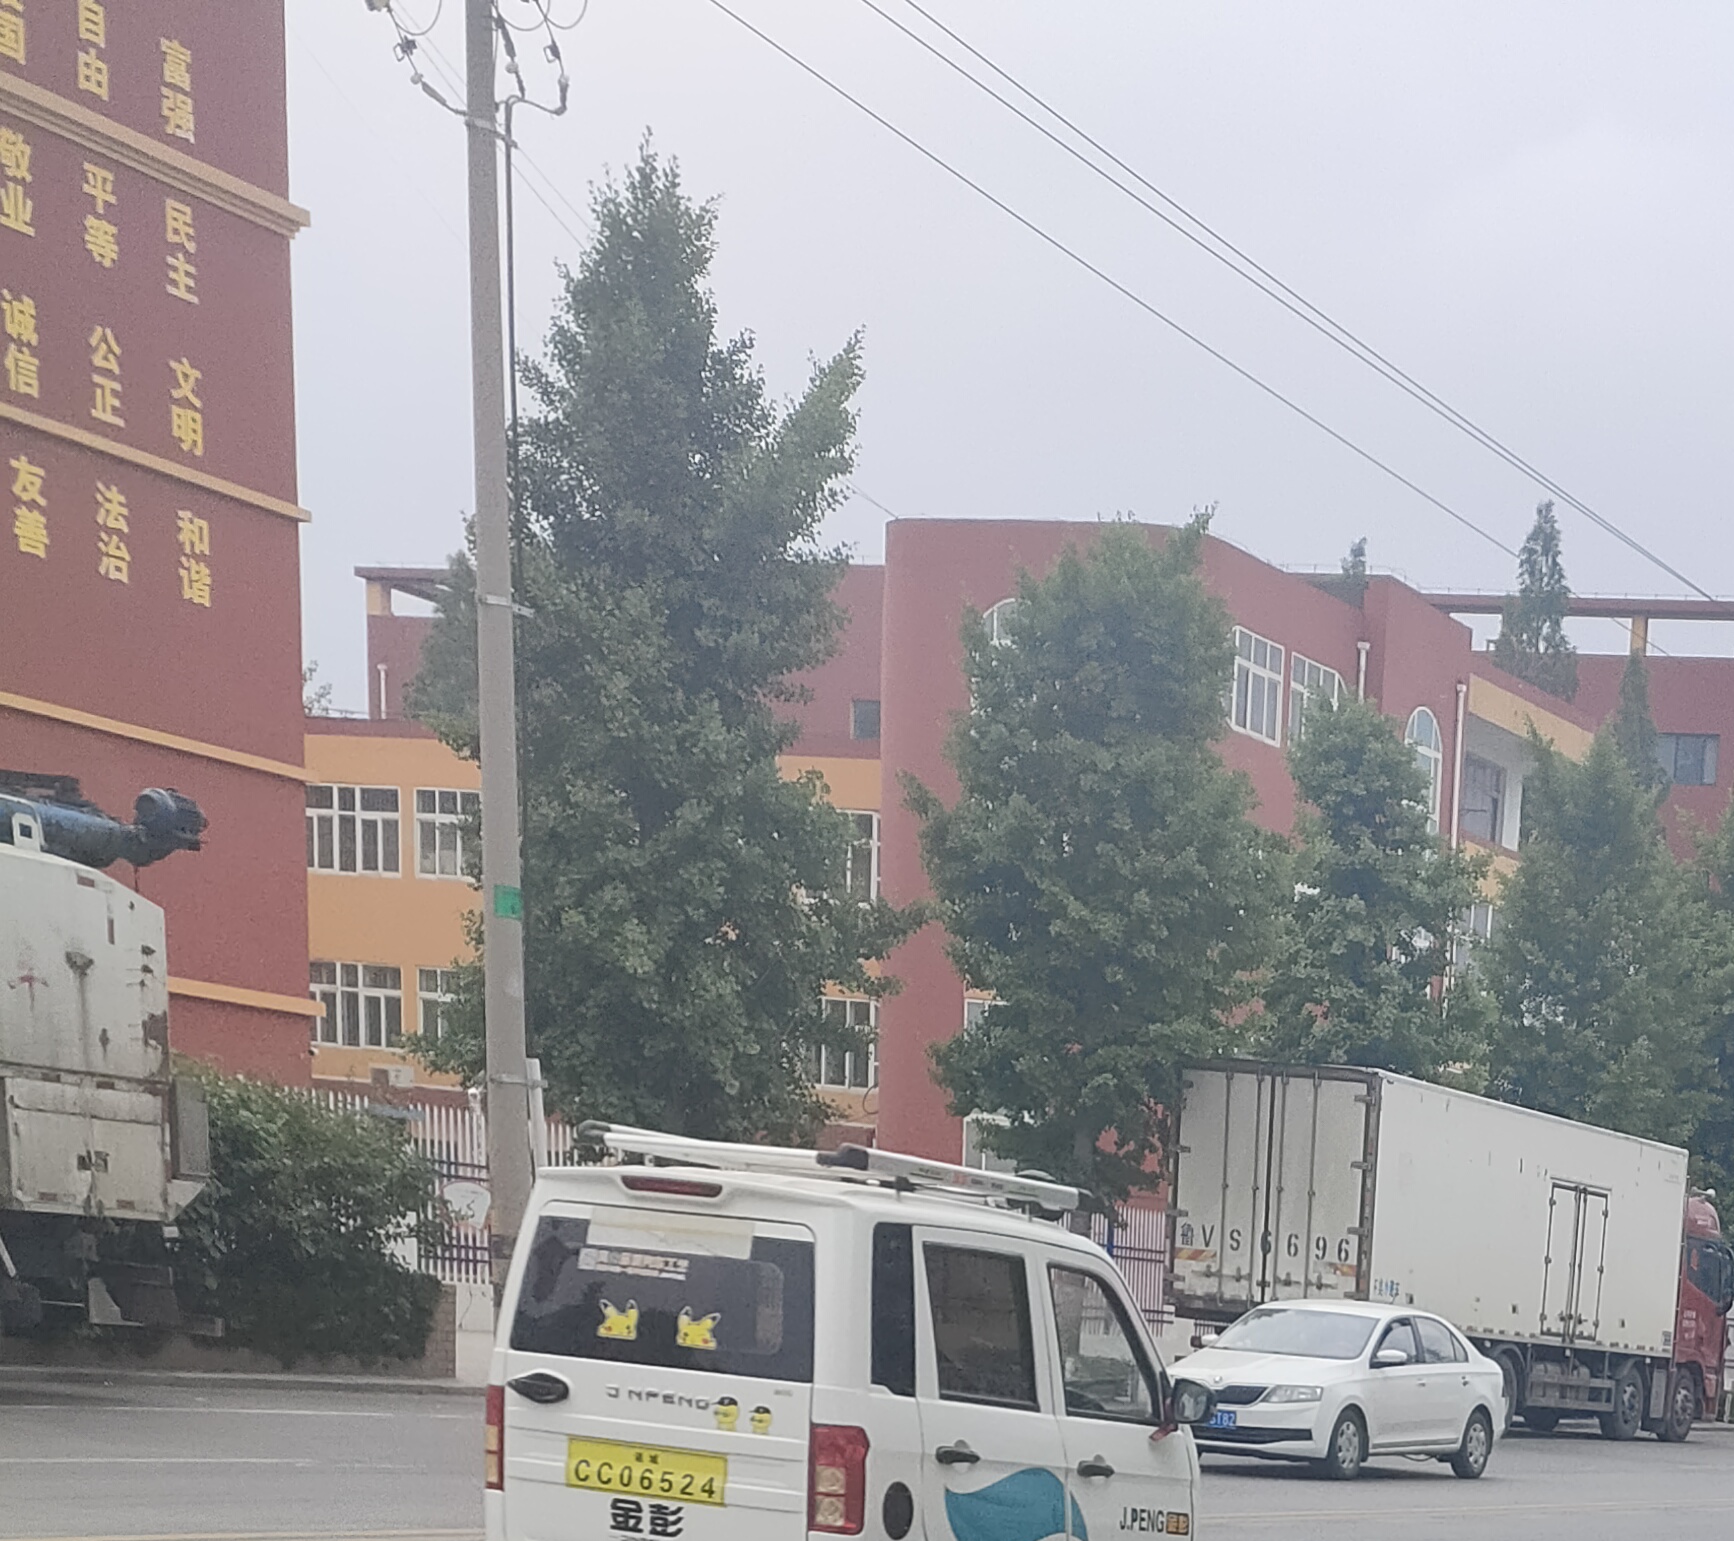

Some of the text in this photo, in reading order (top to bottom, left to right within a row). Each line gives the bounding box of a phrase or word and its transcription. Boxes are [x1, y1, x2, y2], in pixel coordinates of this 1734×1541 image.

[0, 127, 35, 237] 敬业
[1, 288, 39, 399] 诚信
[78, 0, 131, 584] 自由 平等 公正 法治
[160, 37, 212, 608] 富强 民主 文明 和谐
[10, 455, 49, 558] 友善
[573, 1458, 717, 1500] CC06524
[609, 1498, 685, 1538] 金彭
[1119, 1506, 1165, 1534] J.PENG
